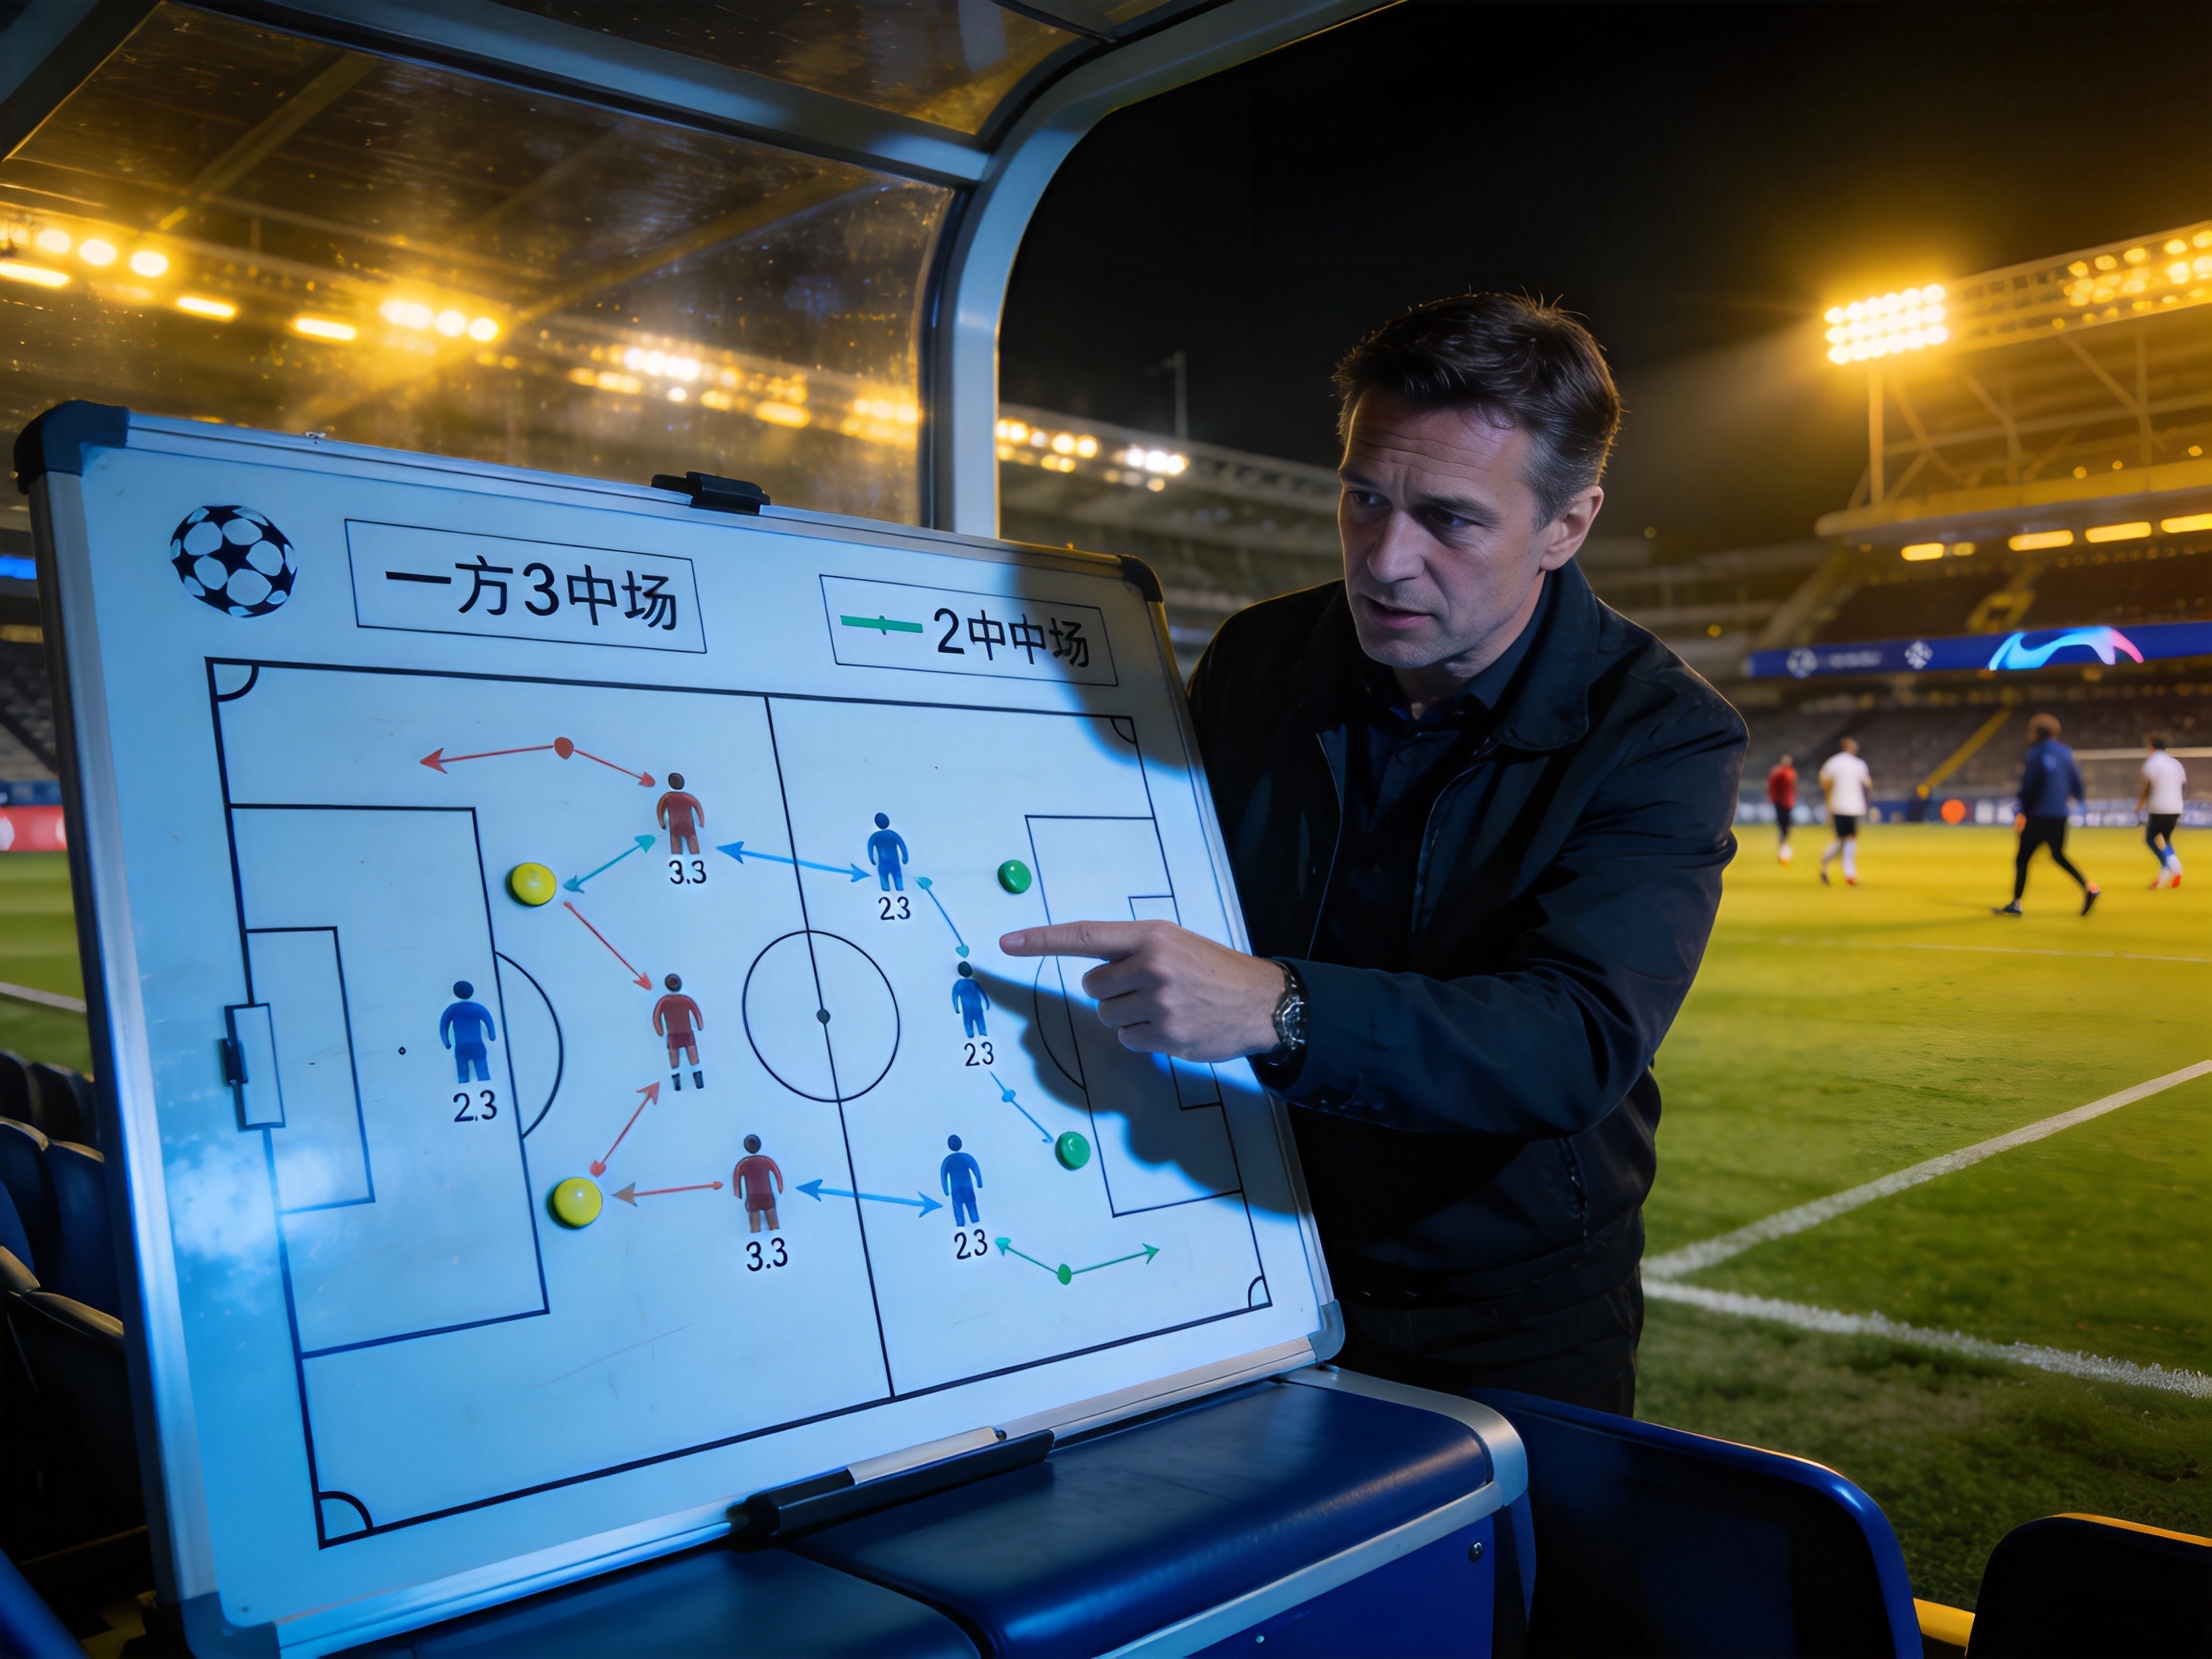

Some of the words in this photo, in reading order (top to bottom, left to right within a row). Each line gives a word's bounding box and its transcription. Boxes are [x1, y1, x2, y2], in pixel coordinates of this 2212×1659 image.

[385, 555, 677, 631] 一方3中场
[668, 859, 708, 885] 3.3
[878, 896, 911, 921] 23
[964, 1041, 995, 1067] 23
[745, 1237, 788, 1272] 3.3
[953, 1228, 988, 1261] 23
